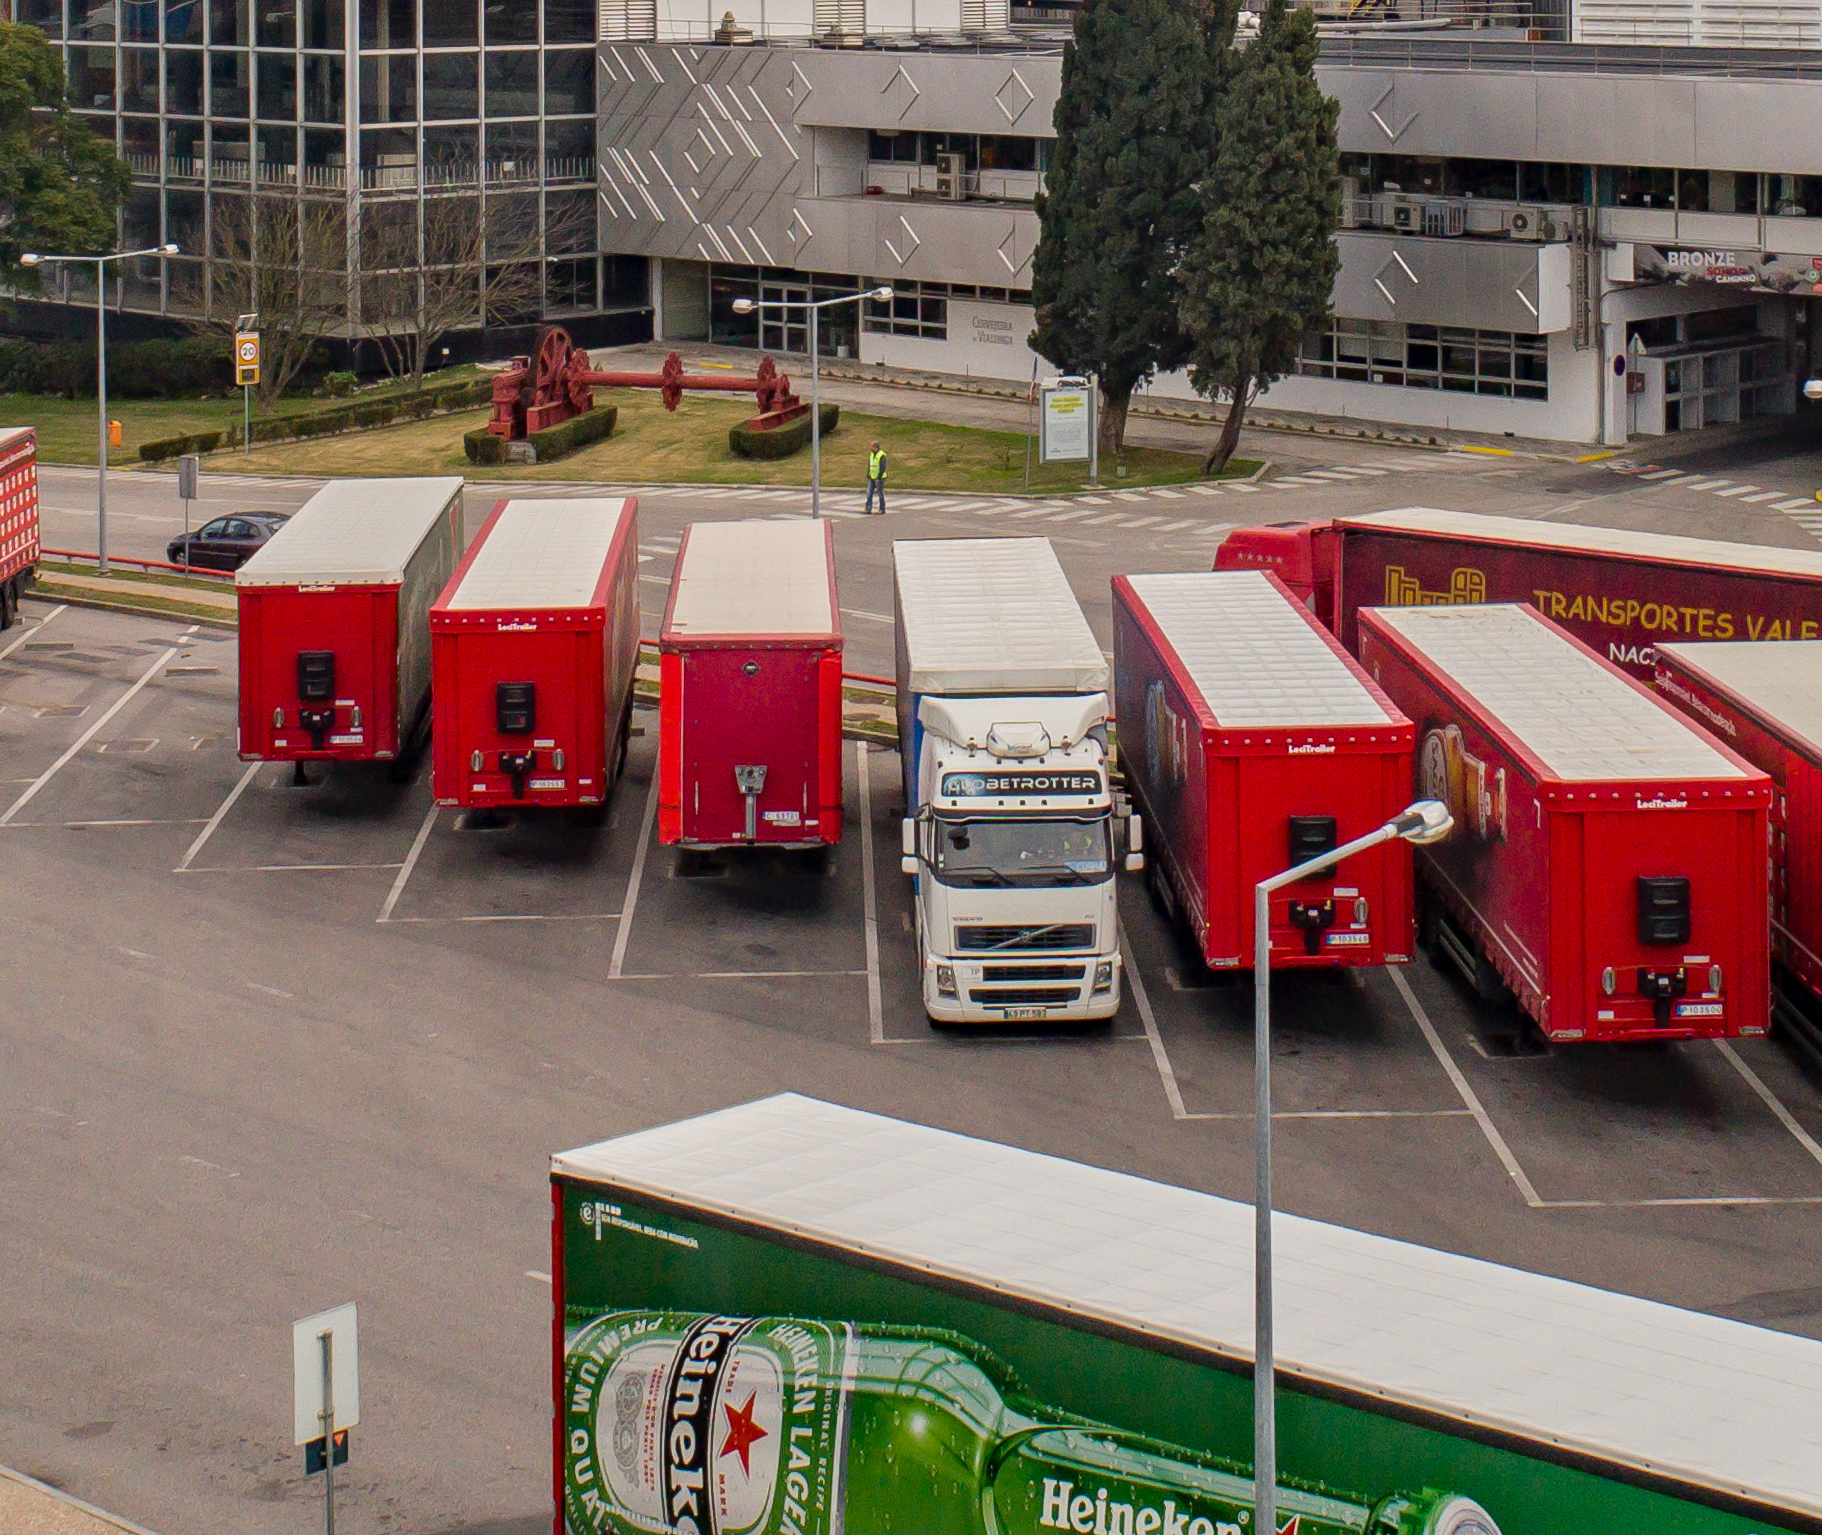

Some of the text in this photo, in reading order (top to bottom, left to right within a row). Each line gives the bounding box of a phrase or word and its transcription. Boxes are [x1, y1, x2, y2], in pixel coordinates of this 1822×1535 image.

[1667, 251, 1736, 267] BRONZE
[242, 347, 255, 357] 20
[1532, 589, 1734, 639] TRANSPORTES
[1609, 643, 1656, 666] NAC
[947, 776, 1097, 794] GLOBETROTTER
[571, 1316, 663, 1413] PREMIUM
[725, 1360, 741, 1394] TRADE
[767, 1323, 820, 1414] HEINEKEN
[718, 1473, 728, 1516] MARK
